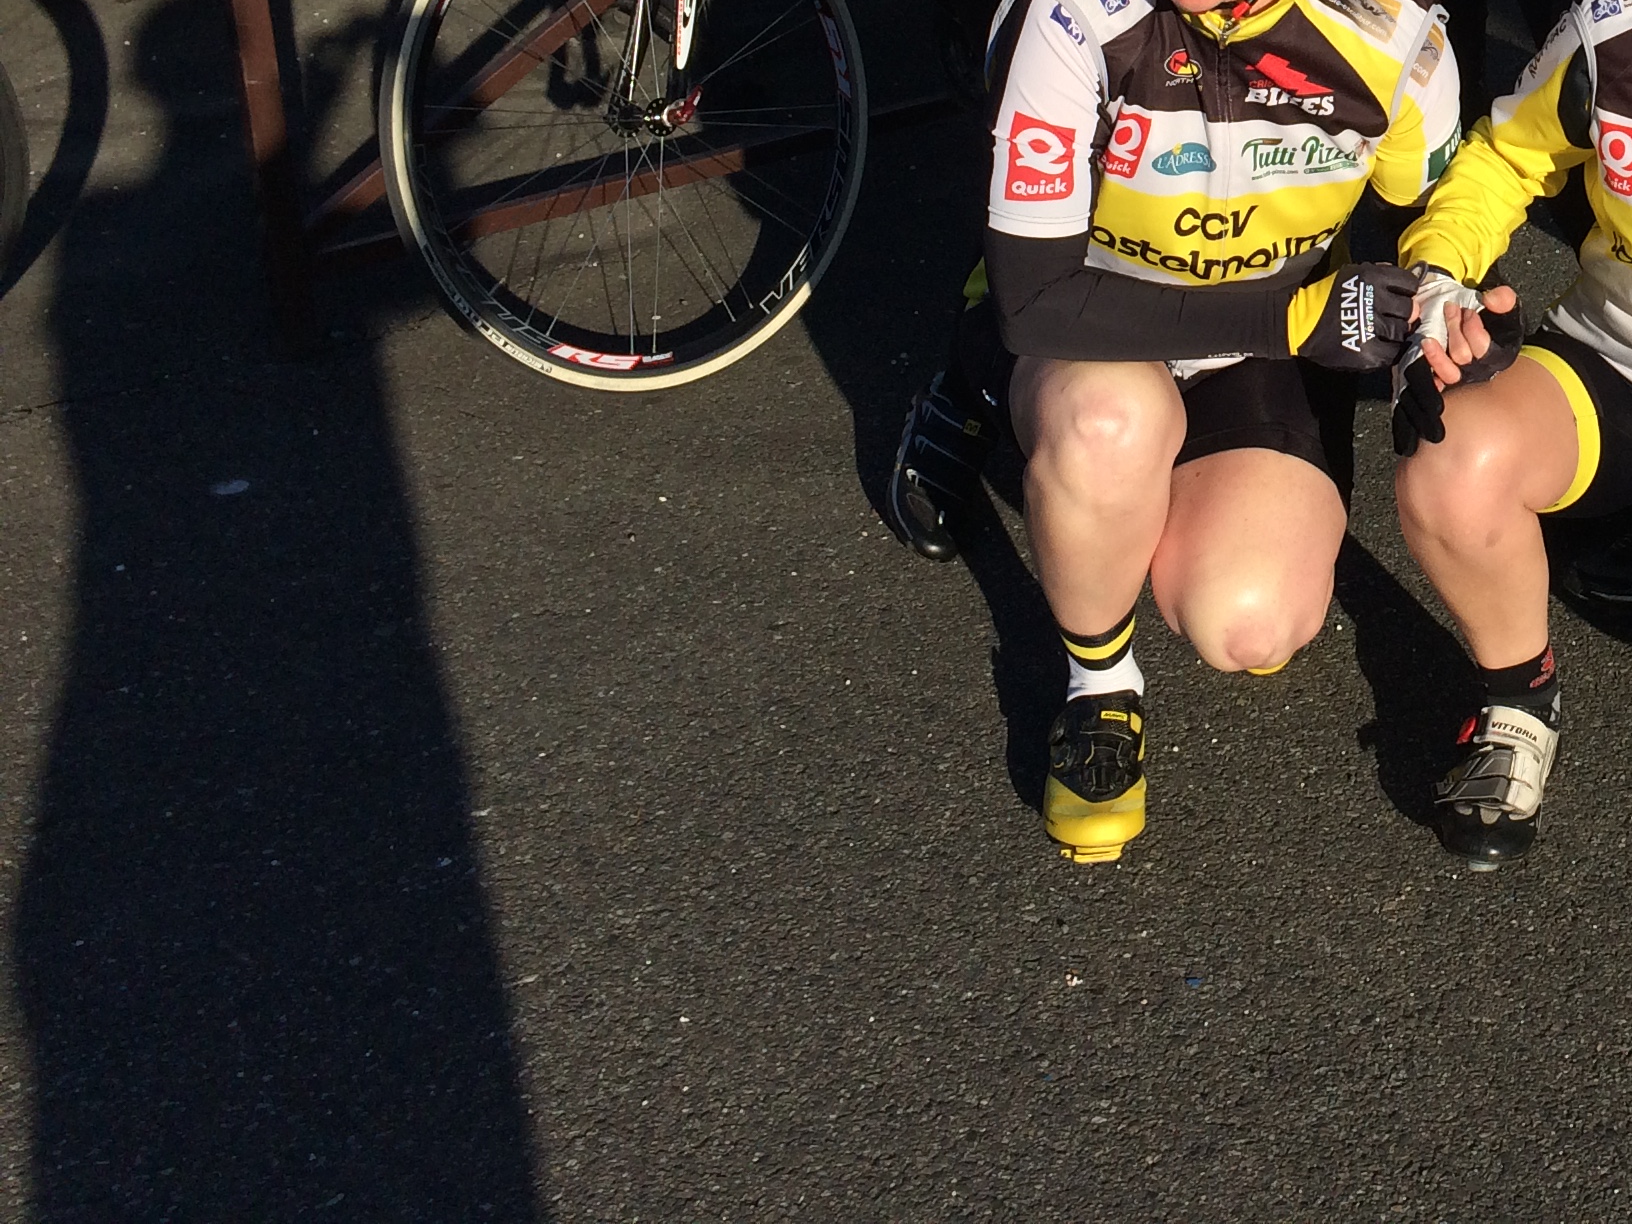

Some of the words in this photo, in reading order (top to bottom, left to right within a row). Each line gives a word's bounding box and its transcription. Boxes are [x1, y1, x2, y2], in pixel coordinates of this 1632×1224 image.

[1241, 137, 1296, 172] Tutti
[1103, 158, 1132, 177] uick
[1011, 179, 1068, 197] Quick
[1341, 274, 1361, 353] AKENA
[1490, 720, 1538, 743] VITTORIA
